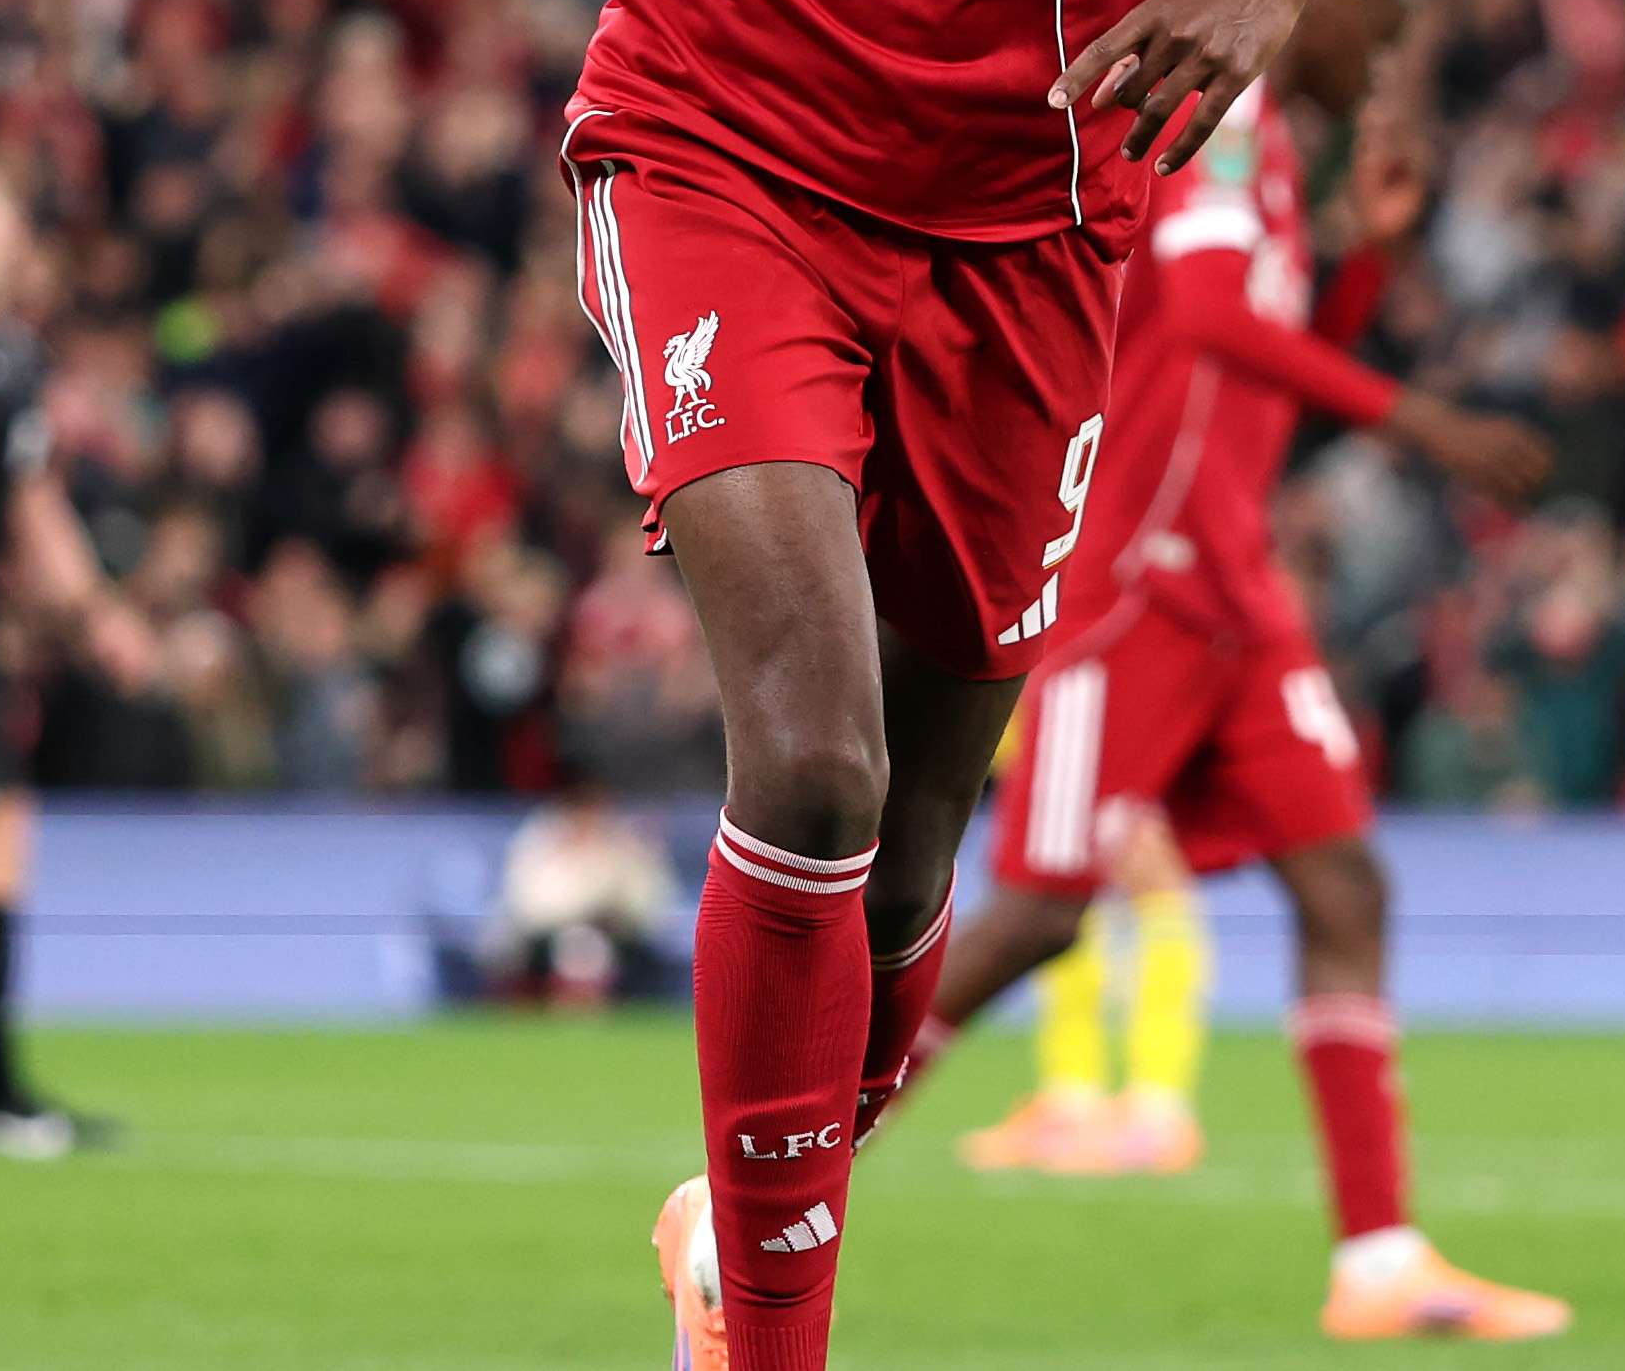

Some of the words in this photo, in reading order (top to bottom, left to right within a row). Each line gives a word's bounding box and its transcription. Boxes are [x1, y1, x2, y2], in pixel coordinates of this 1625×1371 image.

[665, 404, 726, 445] L.F.C.
[1041, 413, 1104, 570] 9
[737, 1122, 841, 1160] LFC
